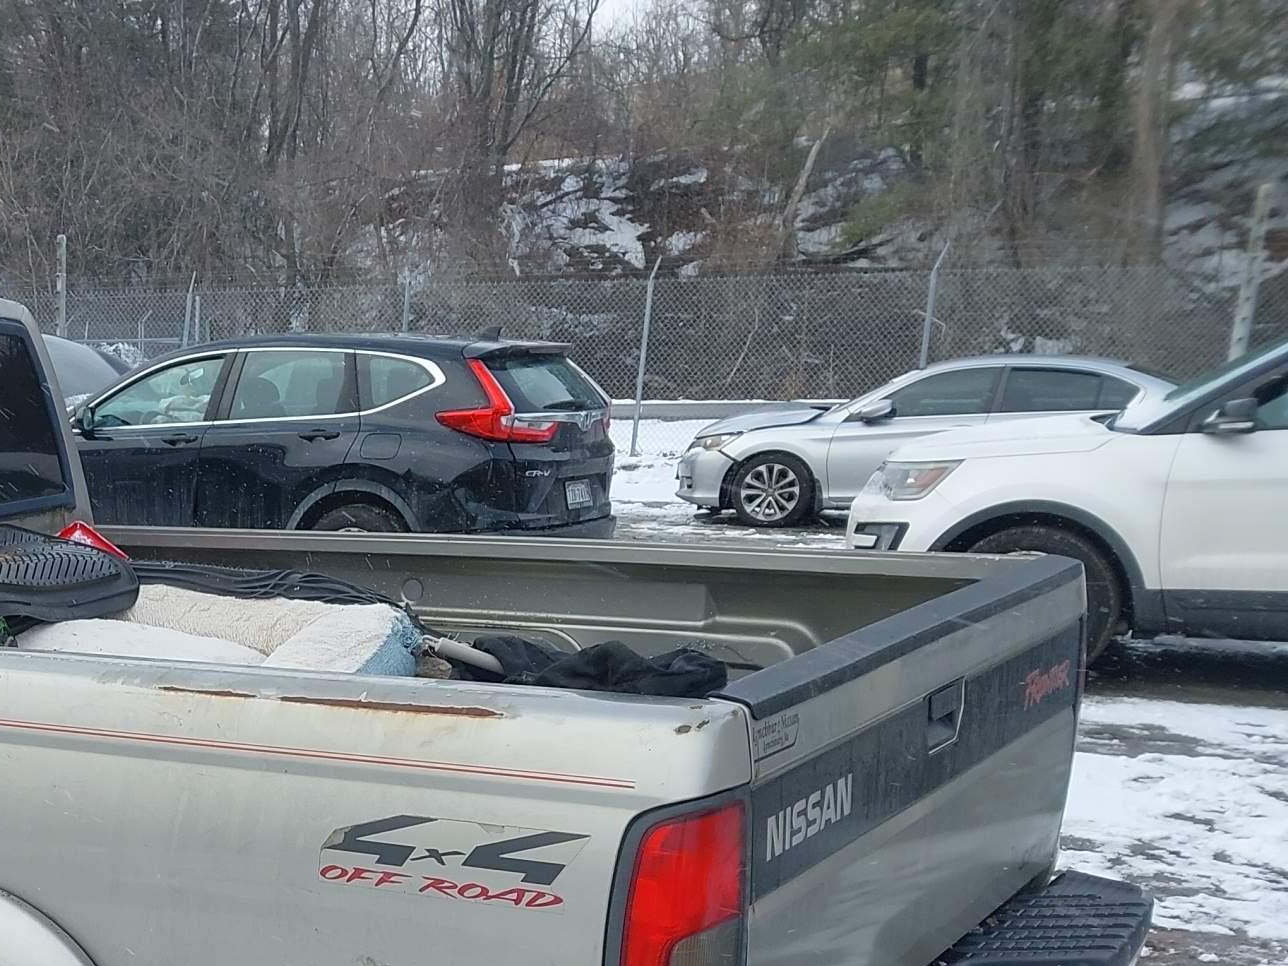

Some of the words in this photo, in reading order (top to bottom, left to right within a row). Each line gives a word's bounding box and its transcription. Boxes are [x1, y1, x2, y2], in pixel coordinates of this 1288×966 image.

[525, 469, 551, 477] CR-V
[766, 773, 853, 862] NISSAN
[319, 864, 413, 887] OFF
[418, 875, 564, 908] ROAD
